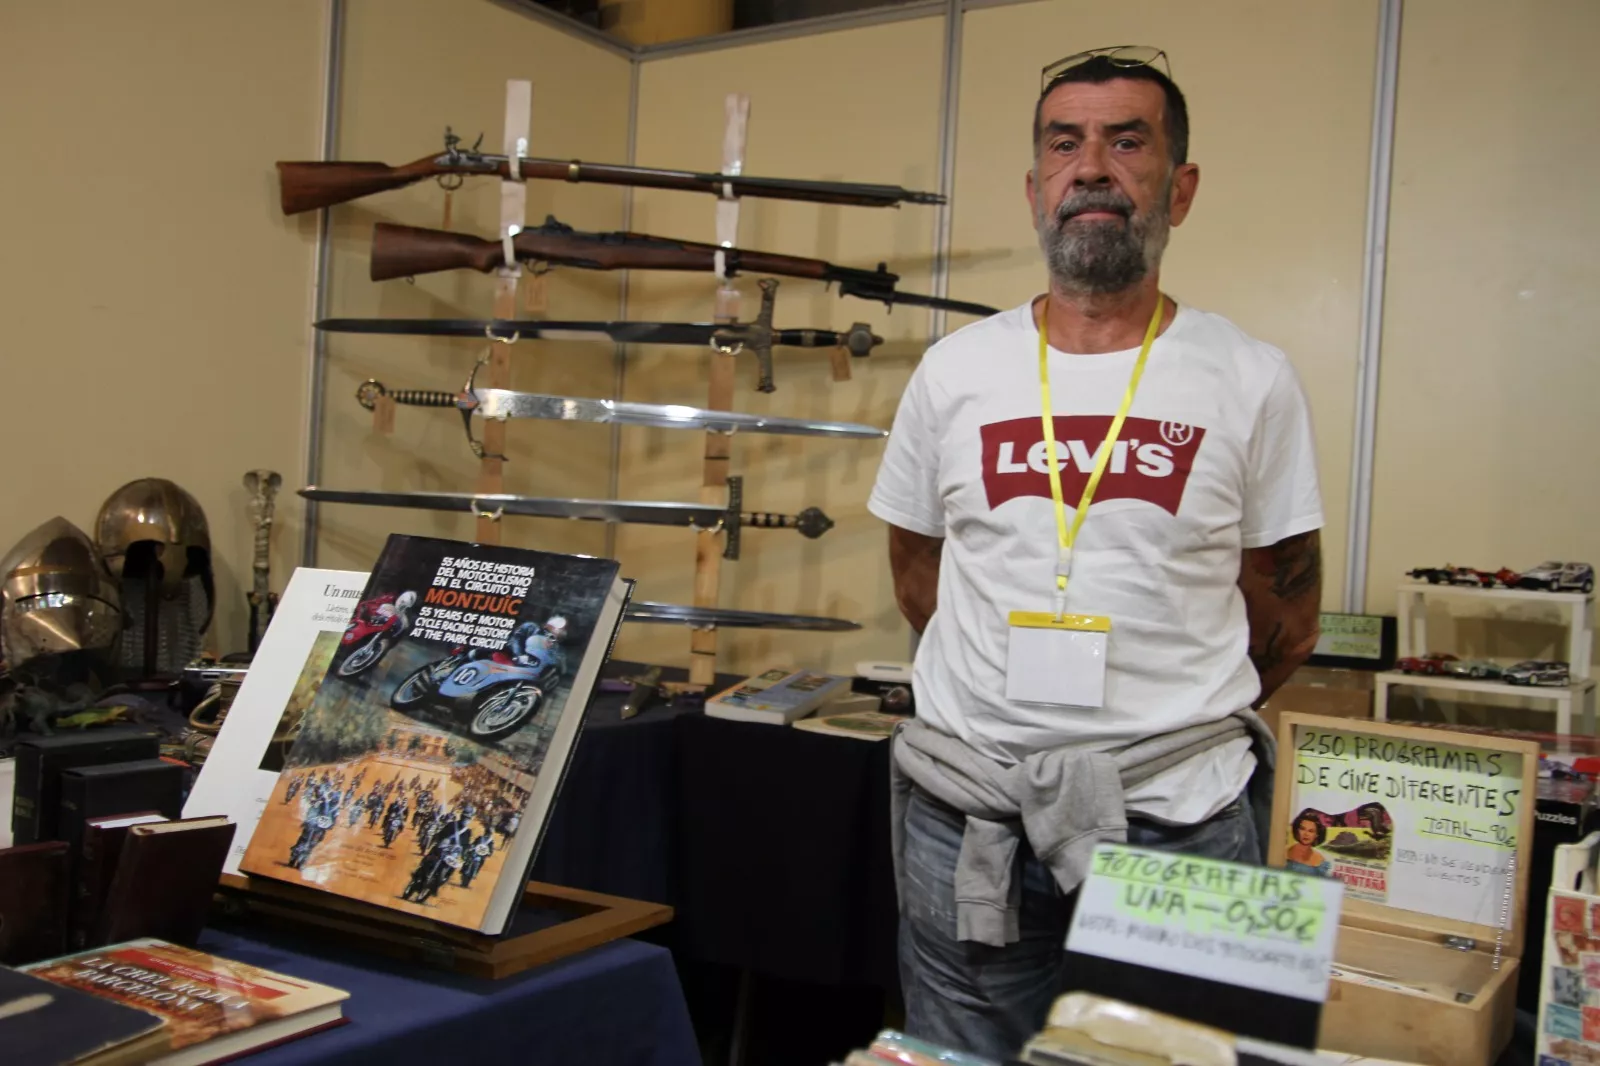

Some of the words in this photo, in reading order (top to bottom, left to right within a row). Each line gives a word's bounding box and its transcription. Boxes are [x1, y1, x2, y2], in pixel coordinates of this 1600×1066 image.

[436, 566, 456, 578] DEL
[457, 569, 532, 587] MOTOCICLISMO
[441, 556, 455, 567] 55
[452, 557, 481, 570] AÑOS
[479, 562, 495, 572] DE
[493, 564, 535, 578] HISTORIA
[323, 584, 341, 598] Un
[432, 576, 450, 587] EN
[449, 578, 462, 589] EL
[464, 580, 511, 595] CIRCUITO
[512, 586, 529, 597] DE
[415, 617, 443, 630] CYCLE
[441, 621, 475, 635] RACING
[473, 626, 512, 640] HISTORY
[419, 606, 434, 616] 55
[433, 608, 462, 621] YEARS
[463, 612, 479, 623] OF
[478, 615, 516, 629] MOTOR
[409, 627, 424, 638] AT
[424, 629, 443, 641] THE
[442, 632, 471, 645] PARK
[469, 636, 508, 650] CIRCUIT
[1298, 732, 1346, 757] 250
[1353, 736, 1503, 777] PROGRAMAS
[1297, 764, 1330, 787] DE
[1424, 816, 1472, 838] TOTAL
[1097, 851, 1306, 902] FOTOGRAFIAS
[1125, 884, 1186, 914] UNA
